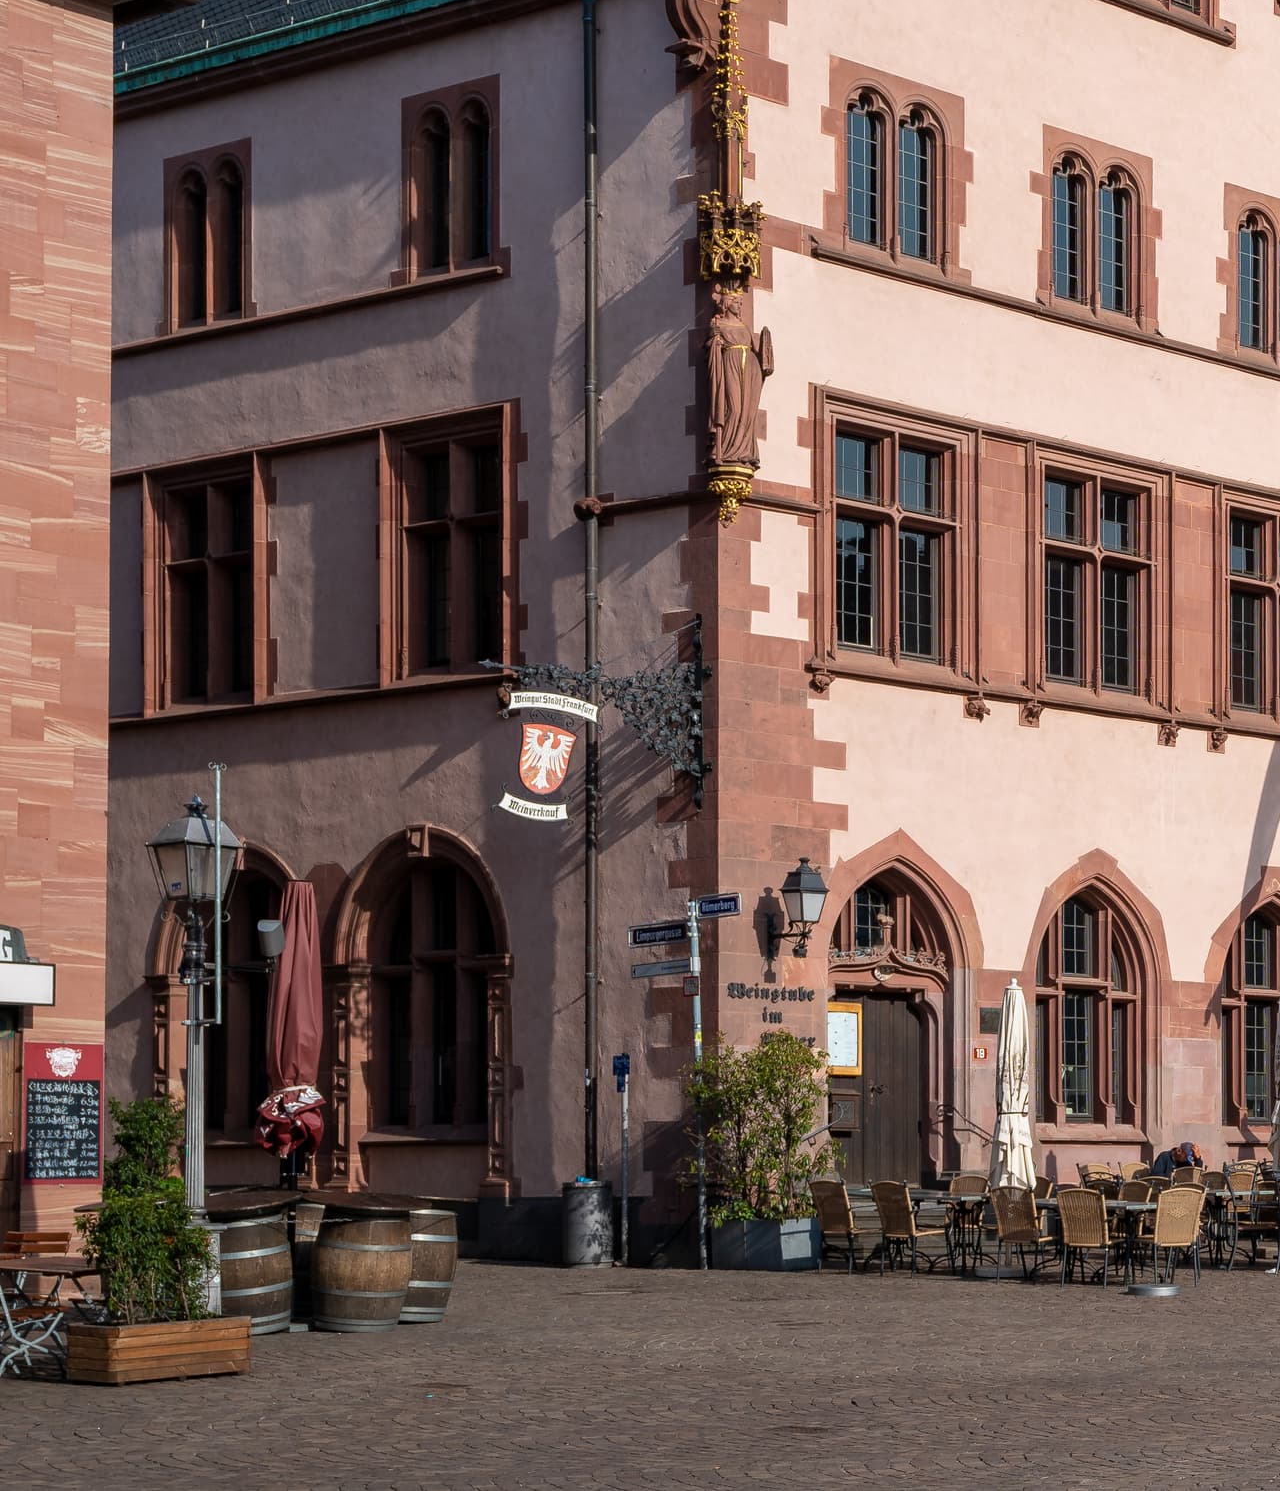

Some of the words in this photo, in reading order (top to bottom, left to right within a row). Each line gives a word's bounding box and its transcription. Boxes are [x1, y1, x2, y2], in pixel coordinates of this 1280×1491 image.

[513, 694, 542, 705] Weingut
[542, 695, 561, 706] Stadt
[562, 697, 595, 716] Frankfurt
[508, 799, 561, 819] Weinverkauf
[701, 900, 735, 913] Römerberg
[727, 982, 816, 1004] Weinstube
[761, 1006, 783, 1024] im
